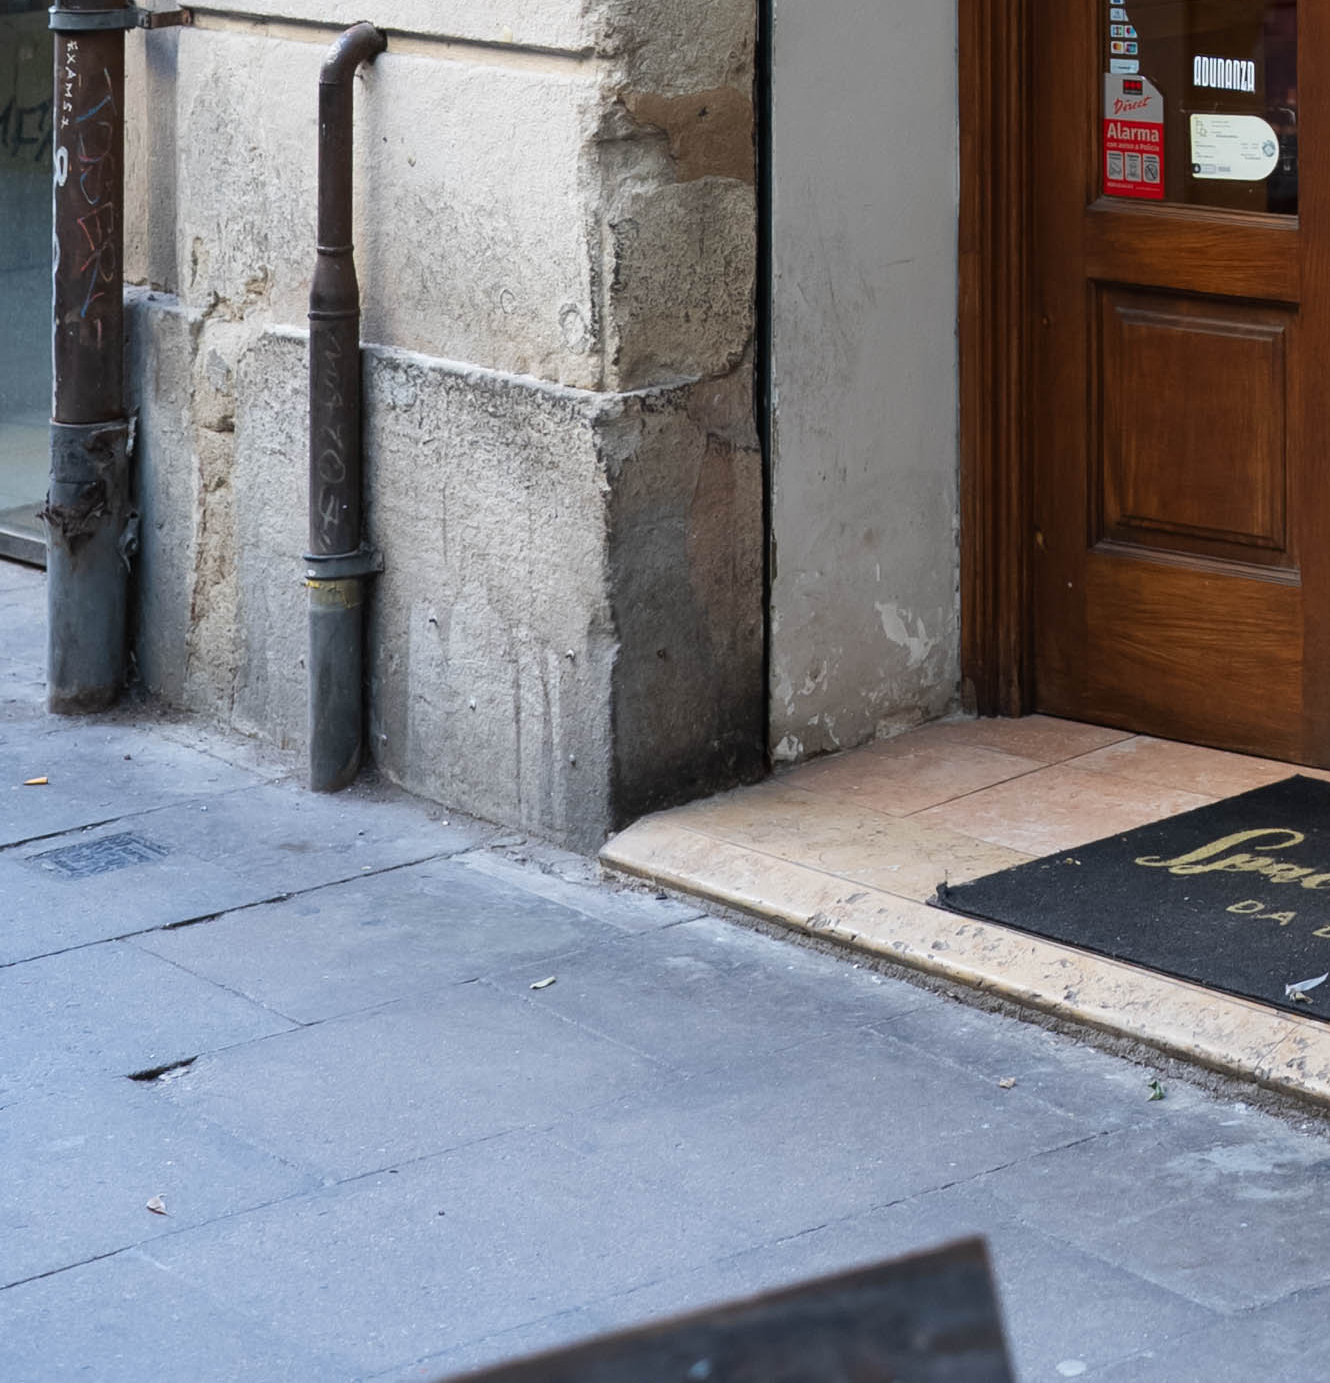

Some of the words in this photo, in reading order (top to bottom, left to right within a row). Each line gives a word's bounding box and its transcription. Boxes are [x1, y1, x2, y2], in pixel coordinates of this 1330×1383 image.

[1193, 55, 1256, 94] ADUNANZA
[1112, 96, 1153, 115] Direct
[1107, 122, 1160, 143] Alarma
[1226, 899, 1298, 926] DA
